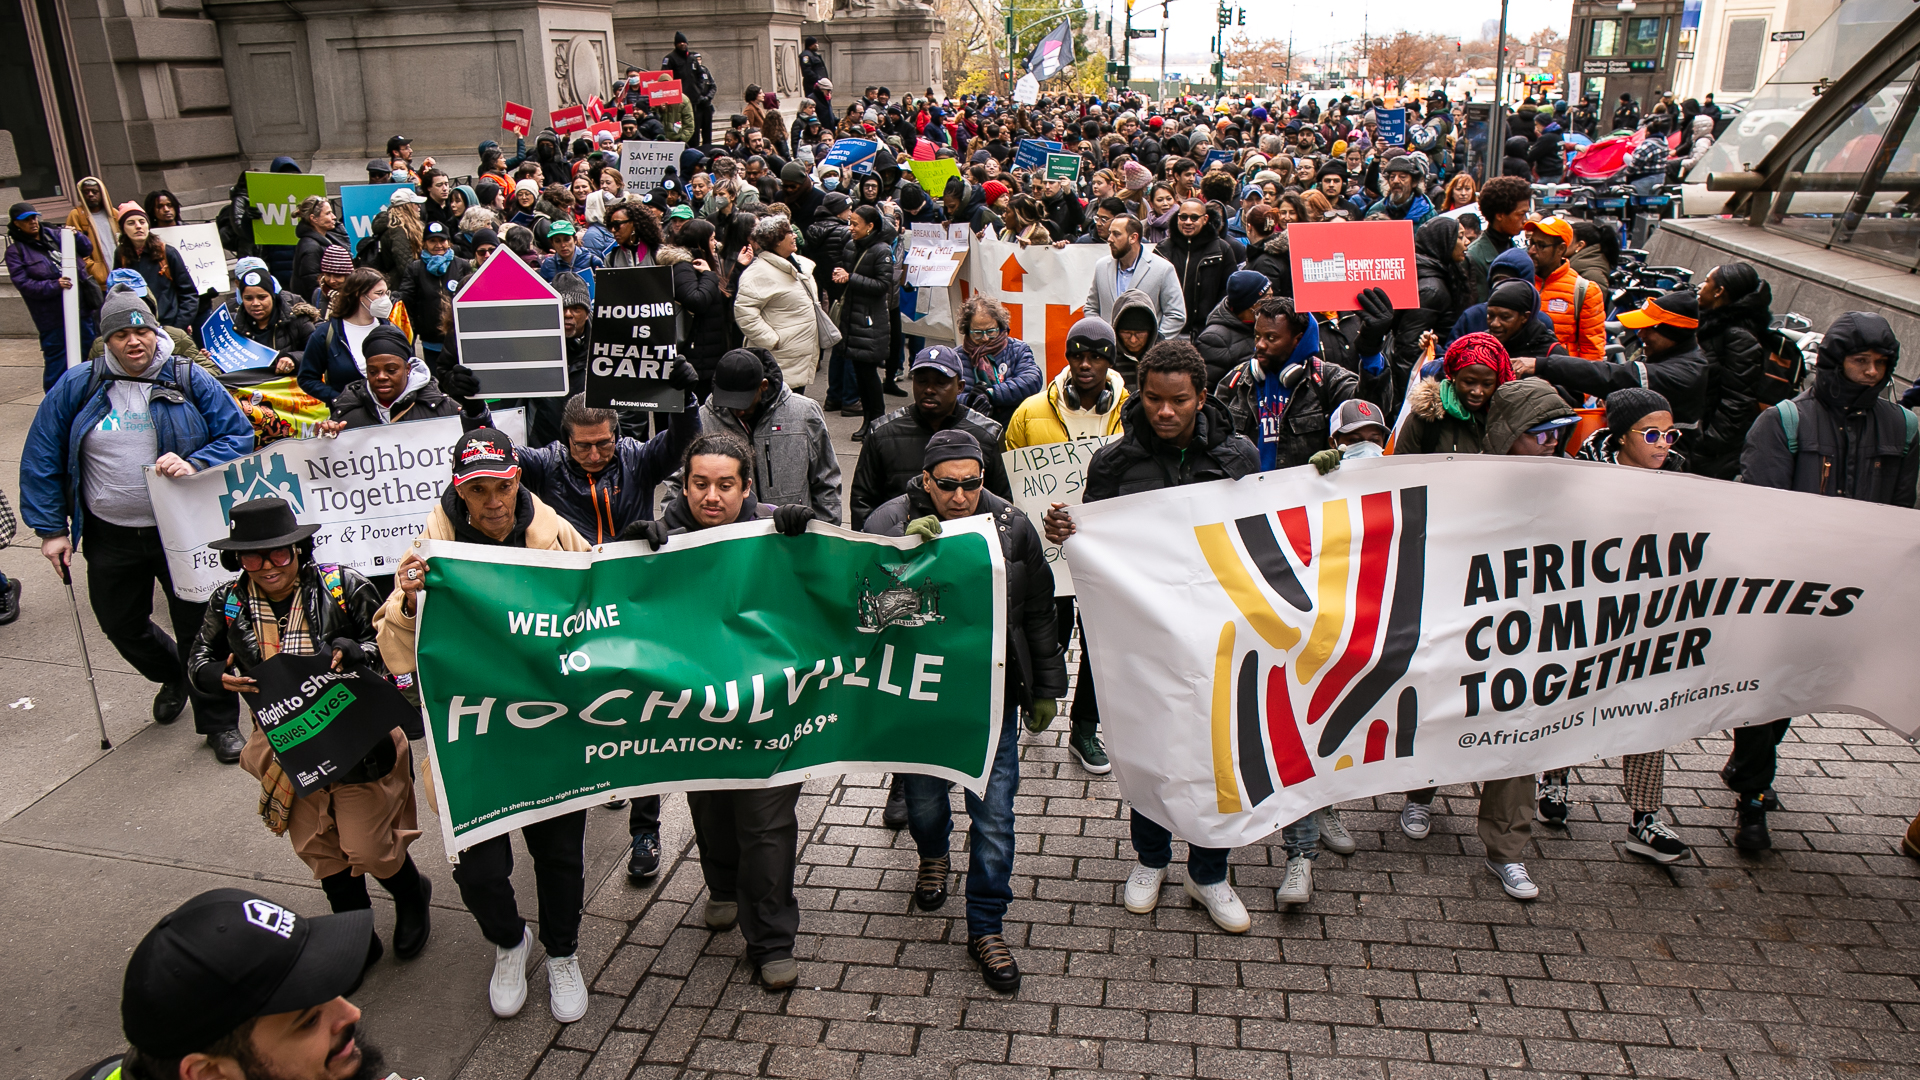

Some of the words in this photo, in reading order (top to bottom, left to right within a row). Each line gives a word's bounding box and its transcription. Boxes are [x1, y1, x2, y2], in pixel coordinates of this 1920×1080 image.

[1584, 60, 1607, 68] Bowling
[630, 152, 654, 160] SAVE
[656, 152, 674, 161] THE
[628, 167, 657, 175] RIGHT
[627, 181, 661, 189] SHELTE
[256, 194, 298, 226] wi
[180, 239, 211, 251] ADAMS
[913, 229, 940, 238] BREAKING
[911, 247, 927, 257] THE
[935, 247, 953, 255] CYCLE
[909, 266, 918, 274] OF
[1347, 259, 1373, 270] HENRY
[1375, 258, 1405, 269] STREET
[1348, 269, 1406, 281] SETTLEMENT
[597, 302, 674, 319] HOUSING
[632, 325, 651, 338] IS
[593, 342, 678, 360] HEALTH
[124, 422, 153, 432] Toget
[304, 444, 455, 480] Neighbors
[1014, 437, 1108, 472] LIBERTY
[312, 478, 443, 514] Together
[1023, 474, 1057, 497] AND
[341, 526, 356, 543] &
[361, 523, 424, 541] Poverty
[1464, 532, 1710, 606] AFRICAN
[508, 604, 620, 638] WELCOME
[1465, 577, 1864, 661] COMMUNITIES
[560, 650, 591, 674] TO
[1460, 628, 1711, 718] TOGETHER
[448, 644, 944, 742] HOCHULVILLE
[257, 704, 288, 726] Right
[284, 696, 304, 711] to
[271, 724, 306, 747] Saves
[302, 690, 349, 730] Lives
[1458, 711, 1584, 748] @AfricansUS
[1600, 678, 1760, 720] www.africans.us
[585, 736, 743, 764] POPULATION:
[454, 821, 470, 832] mber
[471, 817, 478, 825] of
[478, 810, 500, 823] people
[509, 800, 535, 810] shelters
[536, 795, 554, 805] each
[555, 790, 572, 800] night
[596, 781, 611, 789] York
